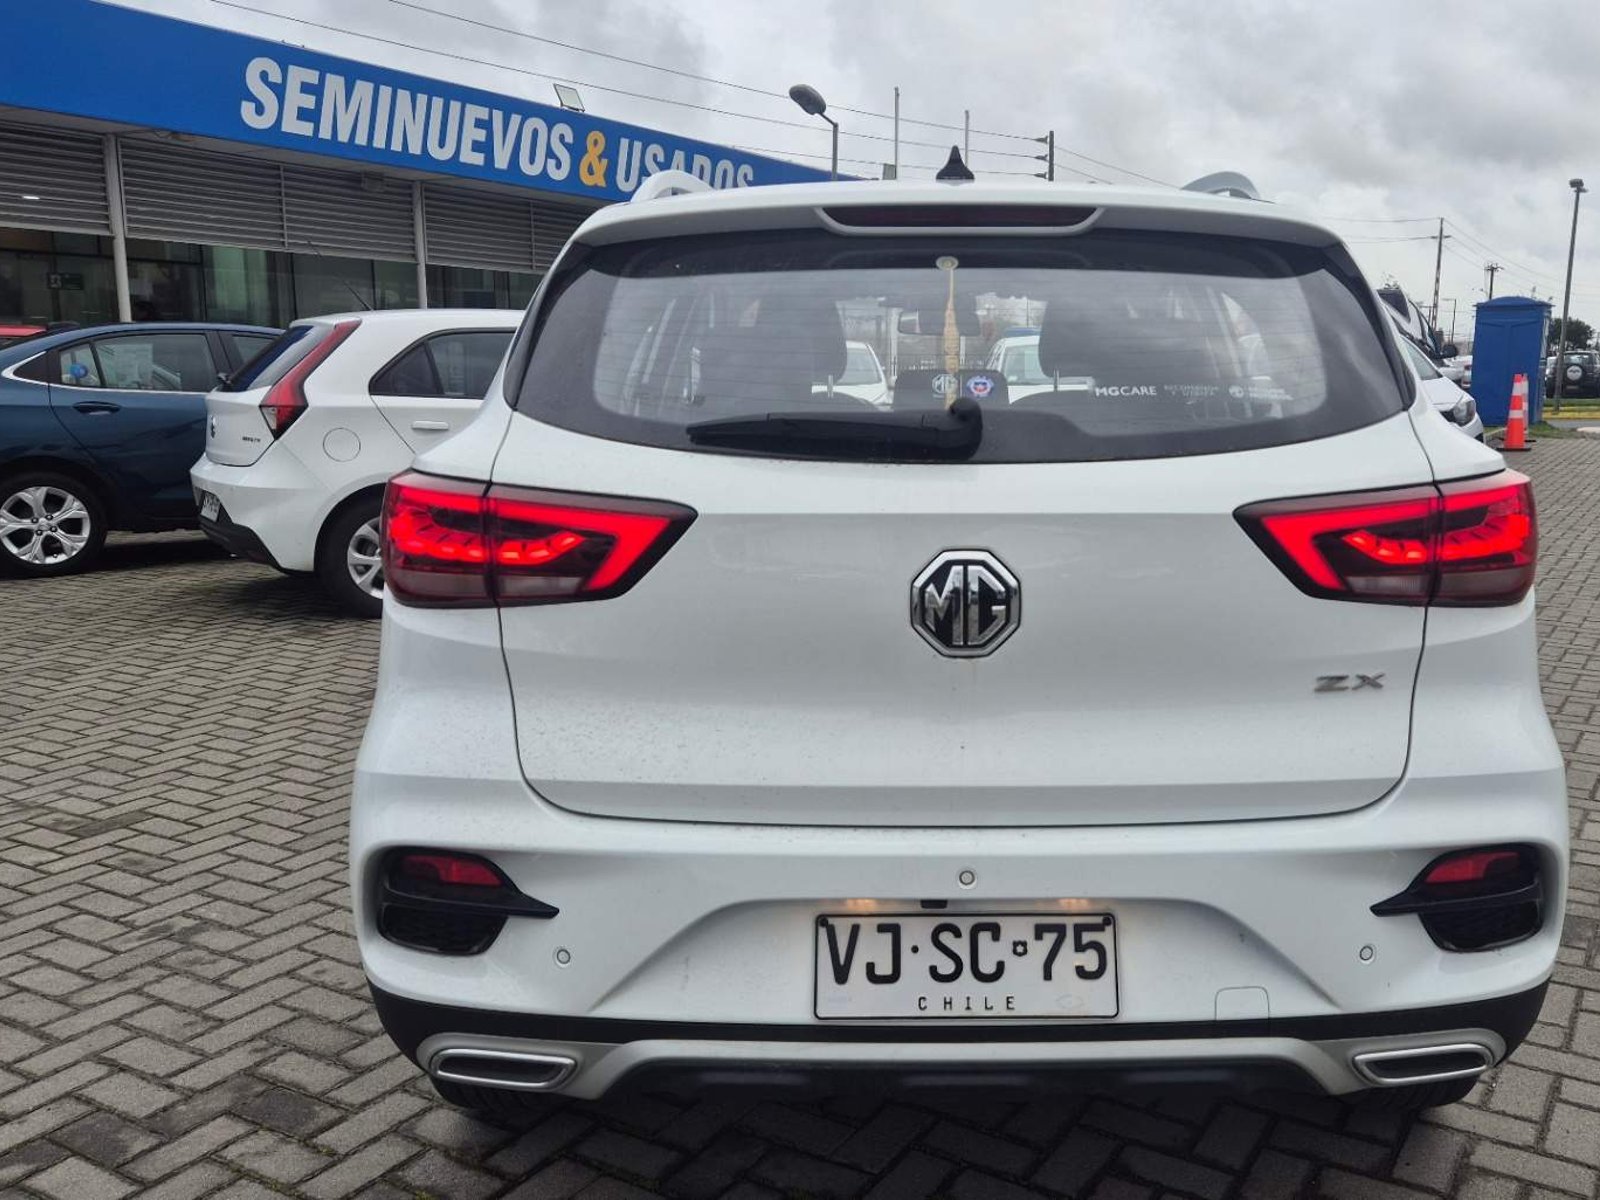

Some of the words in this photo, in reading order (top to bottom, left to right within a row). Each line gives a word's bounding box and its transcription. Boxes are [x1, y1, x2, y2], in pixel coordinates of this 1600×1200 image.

[240, 57, 573, 181] SEMINUEVOS
[579, 130, 608, 188] &
[924, 565, 1007, 646] MG
[1314, 673, 1386, 692] ZX
[918, 996, 1016, 1011] CHILE
